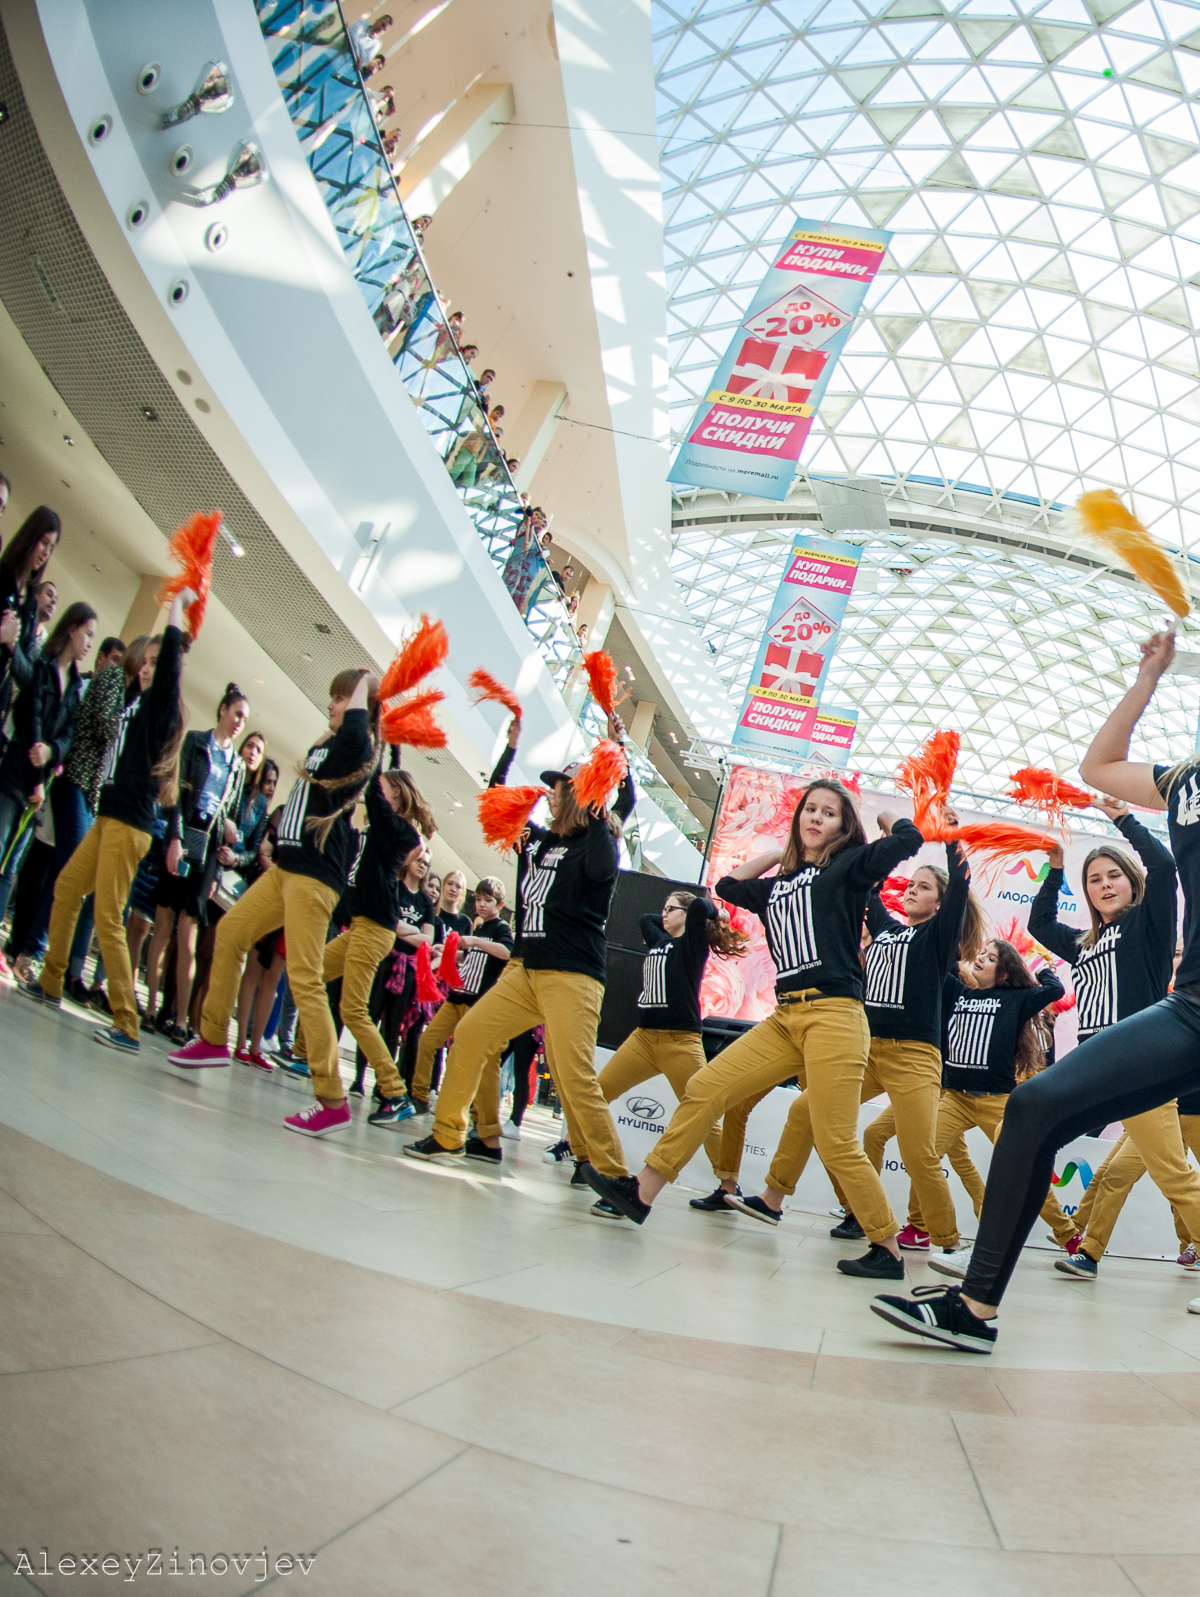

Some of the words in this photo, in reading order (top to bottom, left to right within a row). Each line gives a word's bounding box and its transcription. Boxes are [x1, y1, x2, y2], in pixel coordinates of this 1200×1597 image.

[808, 234, 840, 243] ФЕВРАЛЯ
[794, 244, 845, 260] КУПИ
[753, 312, 841, 338] -20%
[754, 400, 768, 408] 30
[770, 403, 802, 413] МАРТА
[711, 411, 796, 435] ПОЛУЧИ
[702, 426, 787, 450] СКИДКИ
[737, 468, 779, 480] moremall.ru
[795, 560, 830, 574] КУПИ
[774, 621, 831, 643] -20%
[789, 696, 811, 704] МАРТА
[753, 702, 807, 722] ПОЛУЧИ
[747, 713, 802, 733] СКИДКИ
[812, 731, 849, 745] ОДАРКИ
[618, 1115, 667, 1135] HYUNDA
